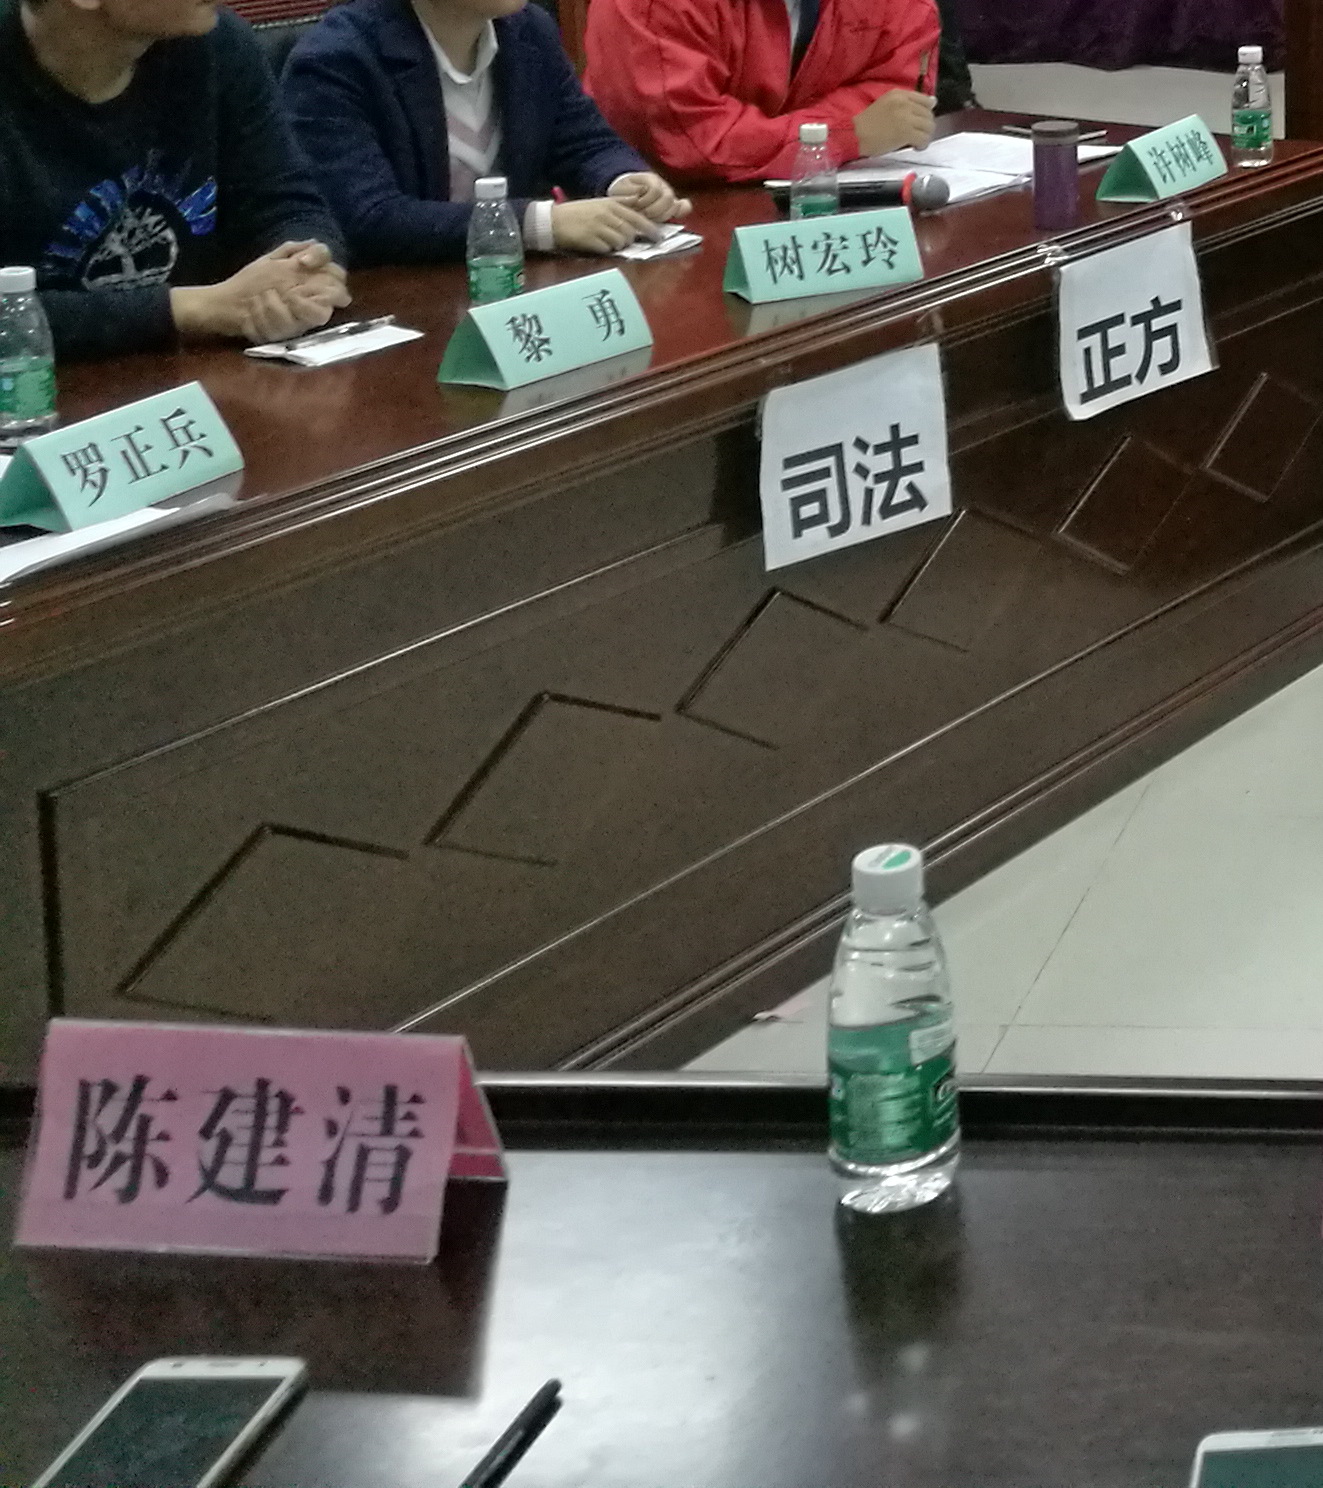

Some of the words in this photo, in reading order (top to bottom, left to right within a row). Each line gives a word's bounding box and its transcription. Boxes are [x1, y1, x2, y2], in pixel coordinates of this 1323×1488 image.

[762, 226, 901, 285] 树宏玲
[505, 290, 626, 364] 黎勇
[1076, 295, 1183, 405] 正方
[60, 408, 215, 508] 罗正兵
[780, 423, 929, 540] 司法
[62, 1073, 427, 1216] 陈建清
